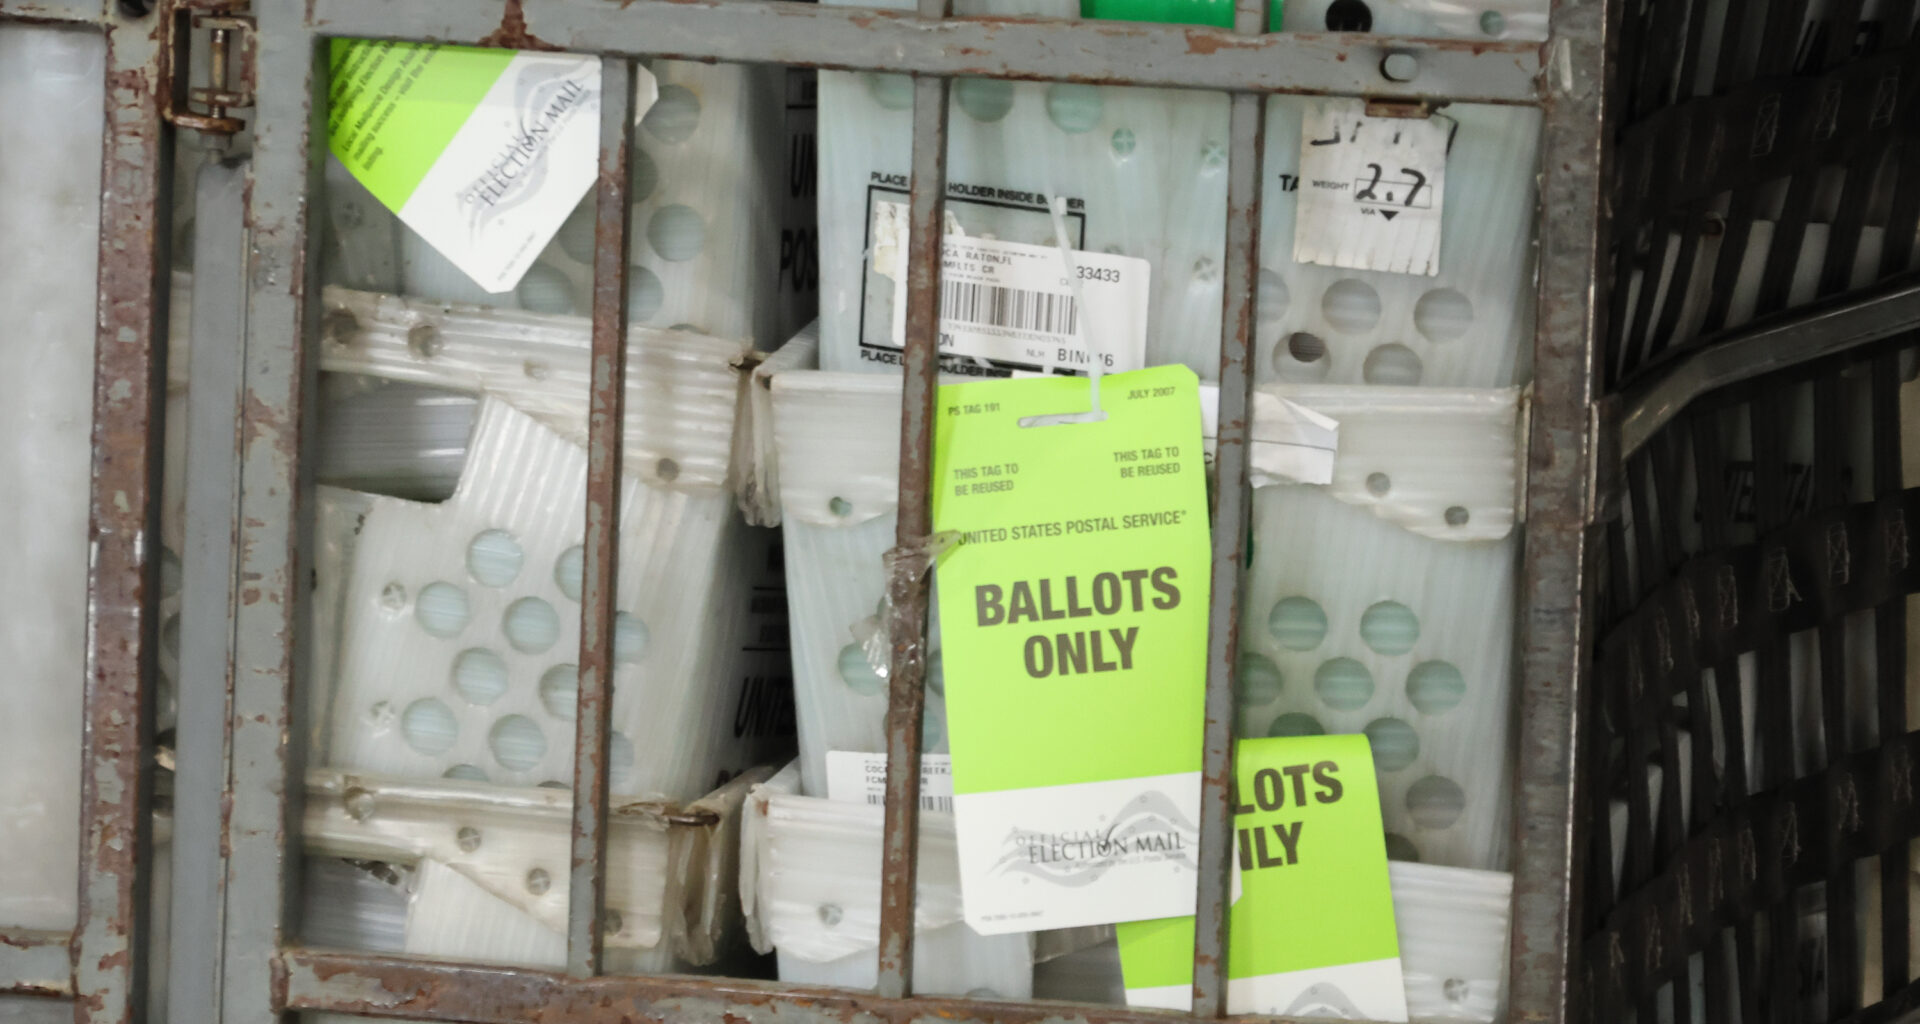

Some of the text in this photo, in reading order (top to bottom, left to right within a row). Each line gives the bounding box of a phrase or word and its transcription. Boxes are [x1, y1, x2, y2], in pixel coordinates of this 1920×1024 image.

[479, 119, 549, 207] ELECTION
[544, 79, 584, 124] MAIL
[871, 172, 908, 187] PLACE
[948, 182, 996, 199] HOLDER
[997, 189, 1034, 204] INSIDE
[1312, 179, 1350, 191] WEIGHT
[1355, 163, 1427, 207] 2.7
[1360, 207, 1376, 217] VIA
[1076, 265, 1121, 284] 33433
[861, 349, 898, 365] PLACE
[1127, 386, 1176, 400] JULY 2007
[948, 402, 1000, 416] PS TAG 191
[1113, 446, 1180, 463] THIS TAG TO
[953, 462, 1019, 480] THIS TAG TO
[1120, 462, 1181, 478] BE REUSED
[954, 479, 1014, 497] BE REUSED
[1011, 521, 1063, 541] STATES
[1066, 516, 1119, 535] POSTAL
[974, 565, 1182, 628] BALLOTS
[1023, 625, 1140, 679] ONLY
[1235, 759, 1344, 815] LOTS
[1028, 838, 1129, 864] ELECTION
[1135, 831, 1186, 853] MAIL
[1238, 820, 1304, 872] NLY
